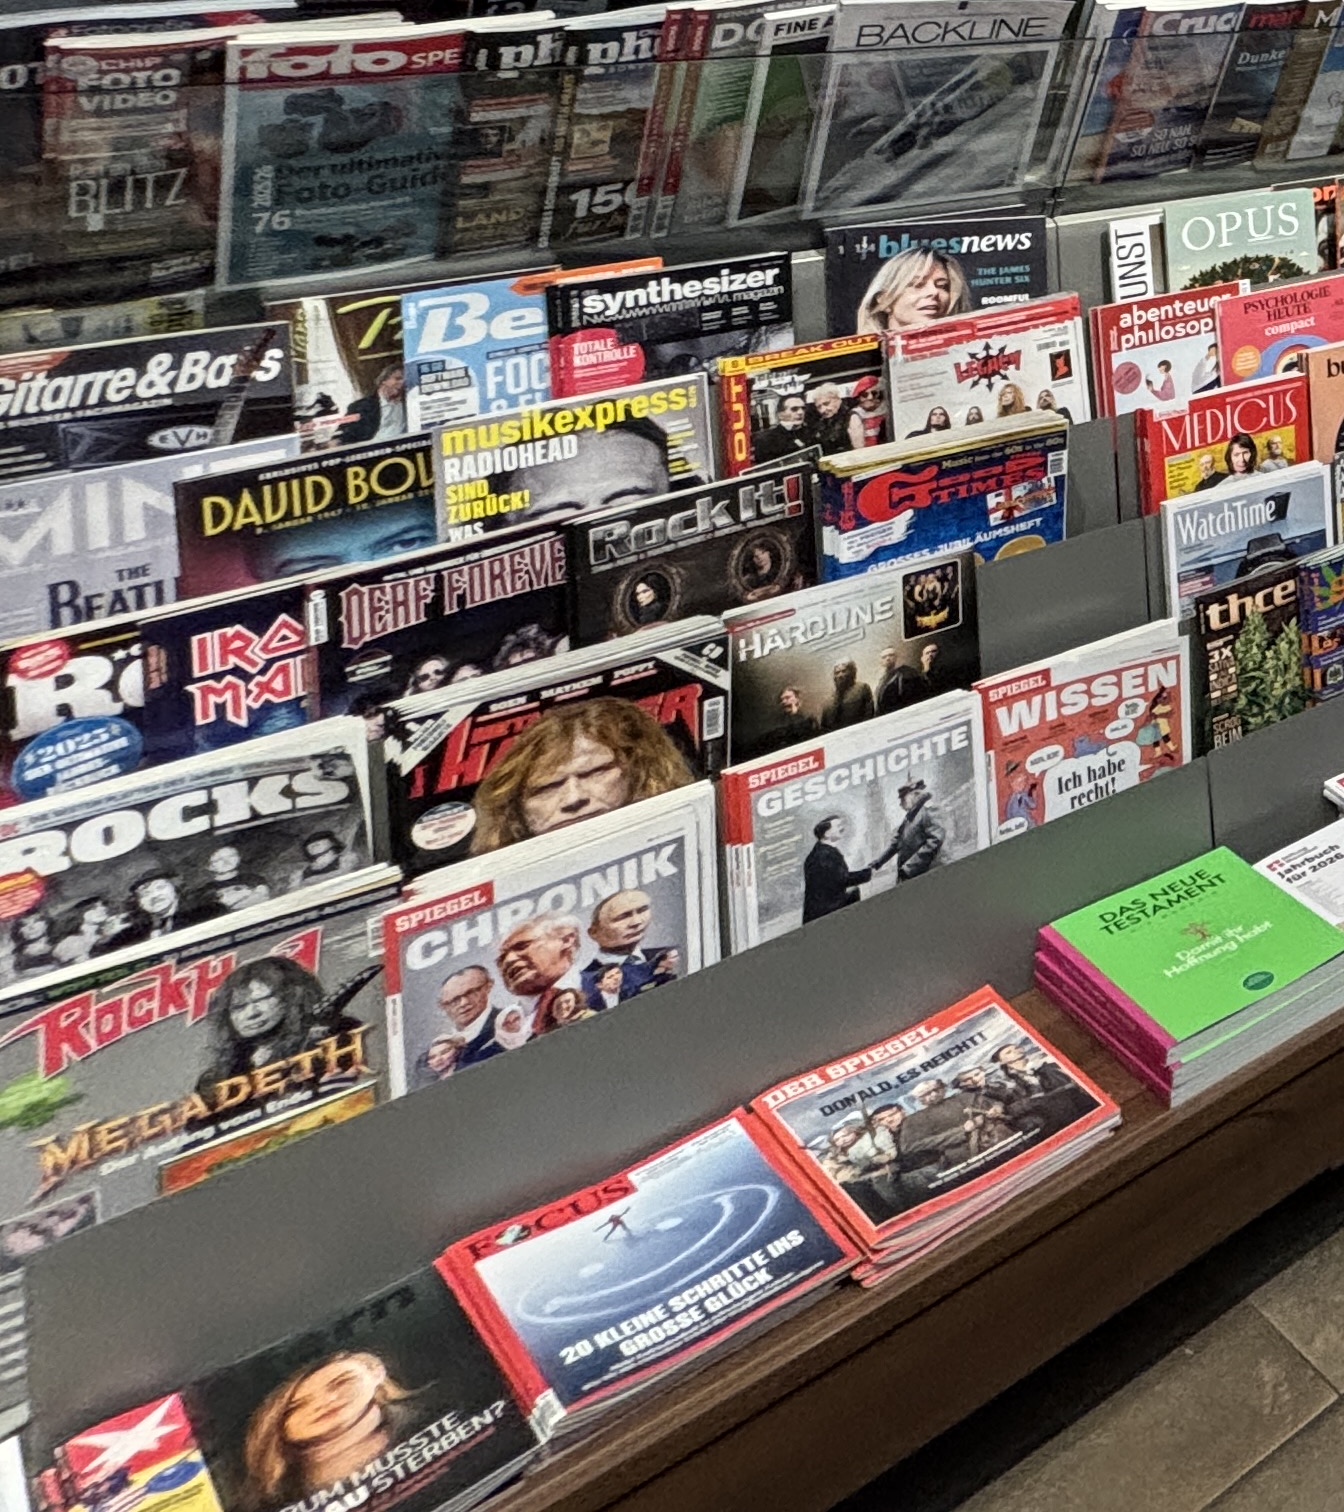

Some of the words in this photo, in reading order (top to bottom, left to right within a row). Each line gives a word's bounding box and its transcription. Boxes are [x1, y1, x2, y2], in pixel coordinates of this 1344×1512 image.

[856, 16, 1050, 49] BACKLINE
[78, 89, 177, 111] VIDEO
[1181, 201, 1301, 254] OPUS
[581, 266, 781, 317] synthesizer
[1242, 284, 1332, 316] PSYCHOLOGIE
[1264, 299, 1314, 324] HEUTE
[571, 337, 615, 354] TOTALE
[1262, 314, 1318, 338] compact
[571, 345, 639, 368] KONTROLLE
[441, 386, 689, 456] musikexpress
[1160, 389, 1300, 453] MEDICUS
[443, 433, 578, 485] RADIOHEAD
[202, 471, 333, 538] DAVID
[445, 478, 490, 503] SIND
[447, 489, 531, 525] ZURÜCK!
[587, 492, 730, 567] Rock
[1175, 496, 1279, 546] WatchTime
[738, 594, 896, 663] HARDLINE
[988, 673, 1049, 703] SPIEGEL
[994, 659, 1178, 738] WISSEN
[746, 757, 821, 790] SPIEGEL
[754, 724, 970, 818] GESCHICHTE
[1056, 766, 1084, 792] Ich
[1085, 755, 1128, 785] habe
[1068, 776, 1119, 812] recht!
[0, 769, 350, 877] ROCKS
[393, 891, 488, 935] SPIEGEL
[403, 841, 683, 973] CHRONIK
[1098, 896, 1147, 925] DAS
[1147, 868, 1214, 902] NEUE
[1100, 873, 1228, 937] TESTAMENT
[1162, 938, 1239, 980] Hoffnung
[1237, 919, 1275, 946] habt
[1174, 933, 1223, 963] Damit
[761, 1073, 828, 1111] DER
[824, 1024, 943, 1081] SPIEGEL
[818, 1079, 893, 1121] DONALD,
[898, 1066, 922, 1086] ES
[28, 1024, 375, 1204] MEGADETH
[557, 1337, 594, 1367] 20
[592, 1302, 673, 1351] KLEINE
[668, 1249, 758, 1317] SCHRITTE
[756, 1228, 806, 1270] INS
[617, 1305, 704, 1360] GROSSE
[702, 1265, 776, 1324] GLÜCK
[351, 1409, 462, 1487] MUSSTE
[371, 1399, 506, 1495] STERBEN?
